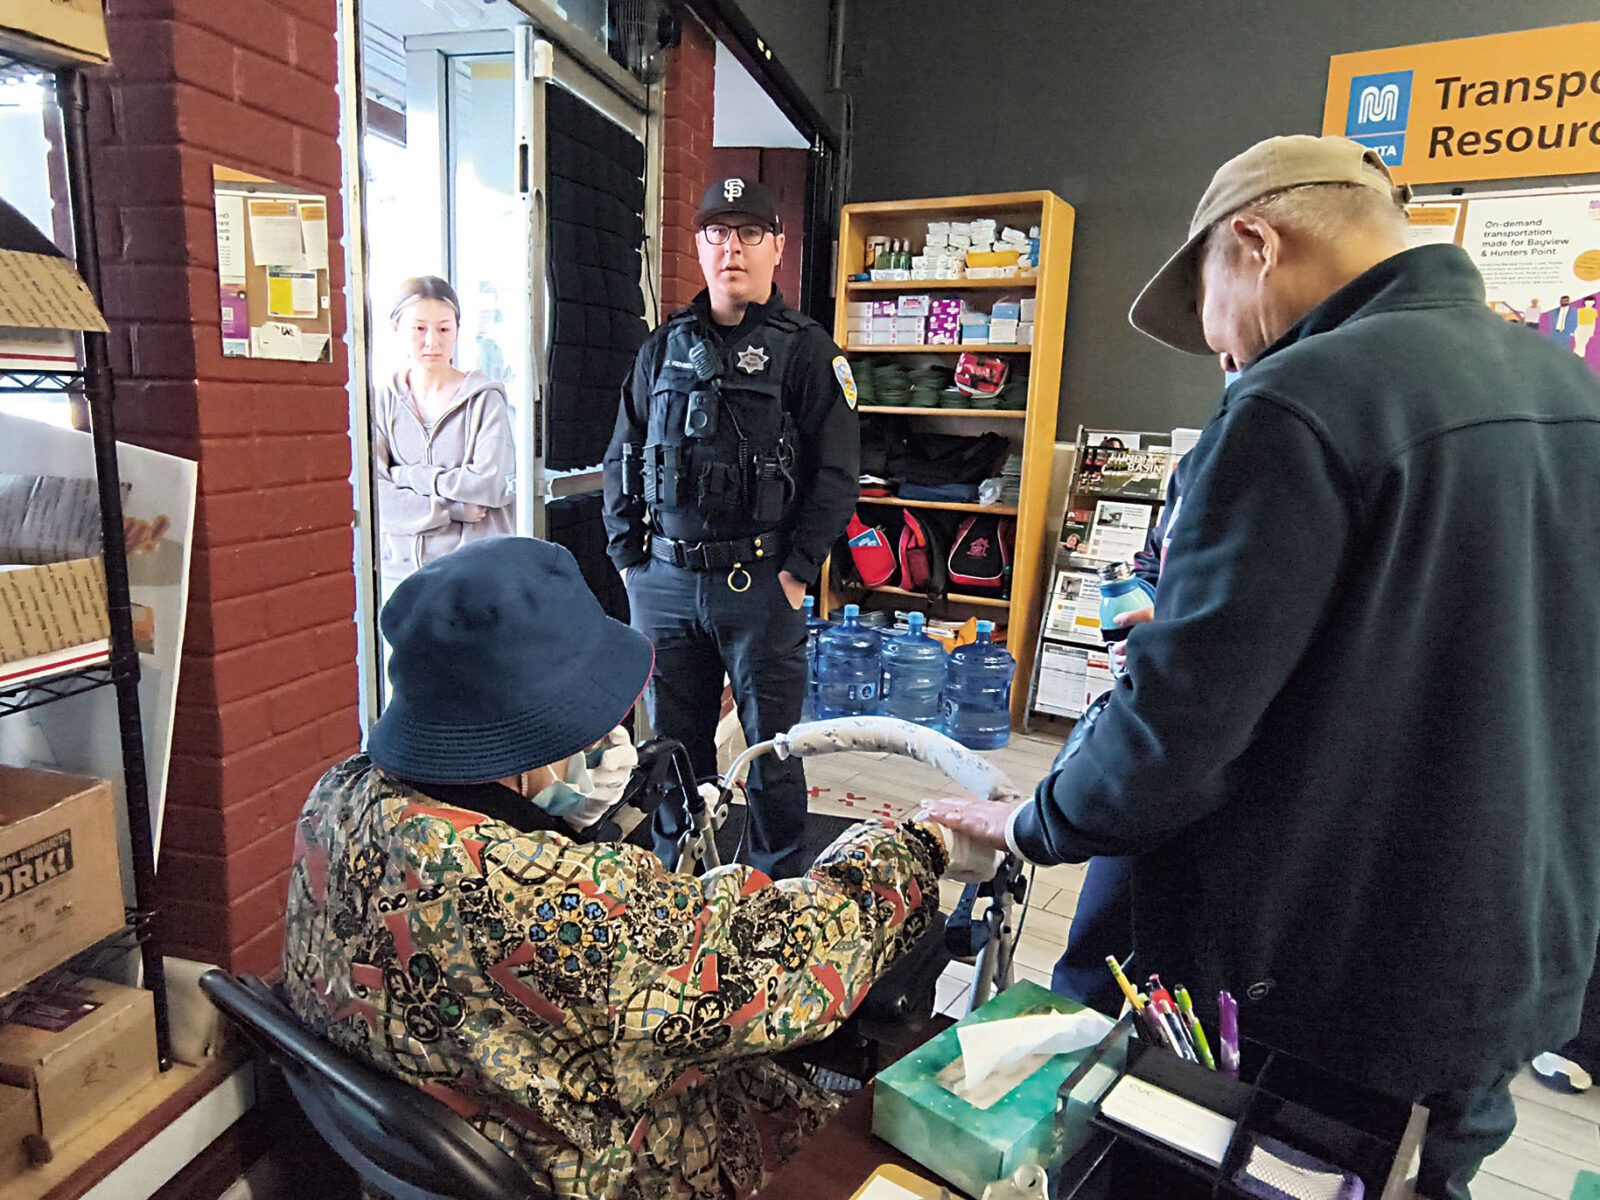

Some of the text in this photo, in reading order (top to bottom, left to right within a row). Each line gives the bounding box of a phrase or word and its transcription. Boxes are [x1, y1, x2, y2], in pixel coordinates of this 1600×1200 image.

[724, 178, 745, 202] SF
[1485, 219, 1542, 229] On-demand
[1484, 229, 1552, 238] transportation
[1511, 239, 1524, 247] for
[1527, 238, 1569, 248] Bayview
[1490, 249, 1528, 257] Hunters
[1531, 248, 1556, 256] Point
[20, 831, 70, 863] PRODUCTS
